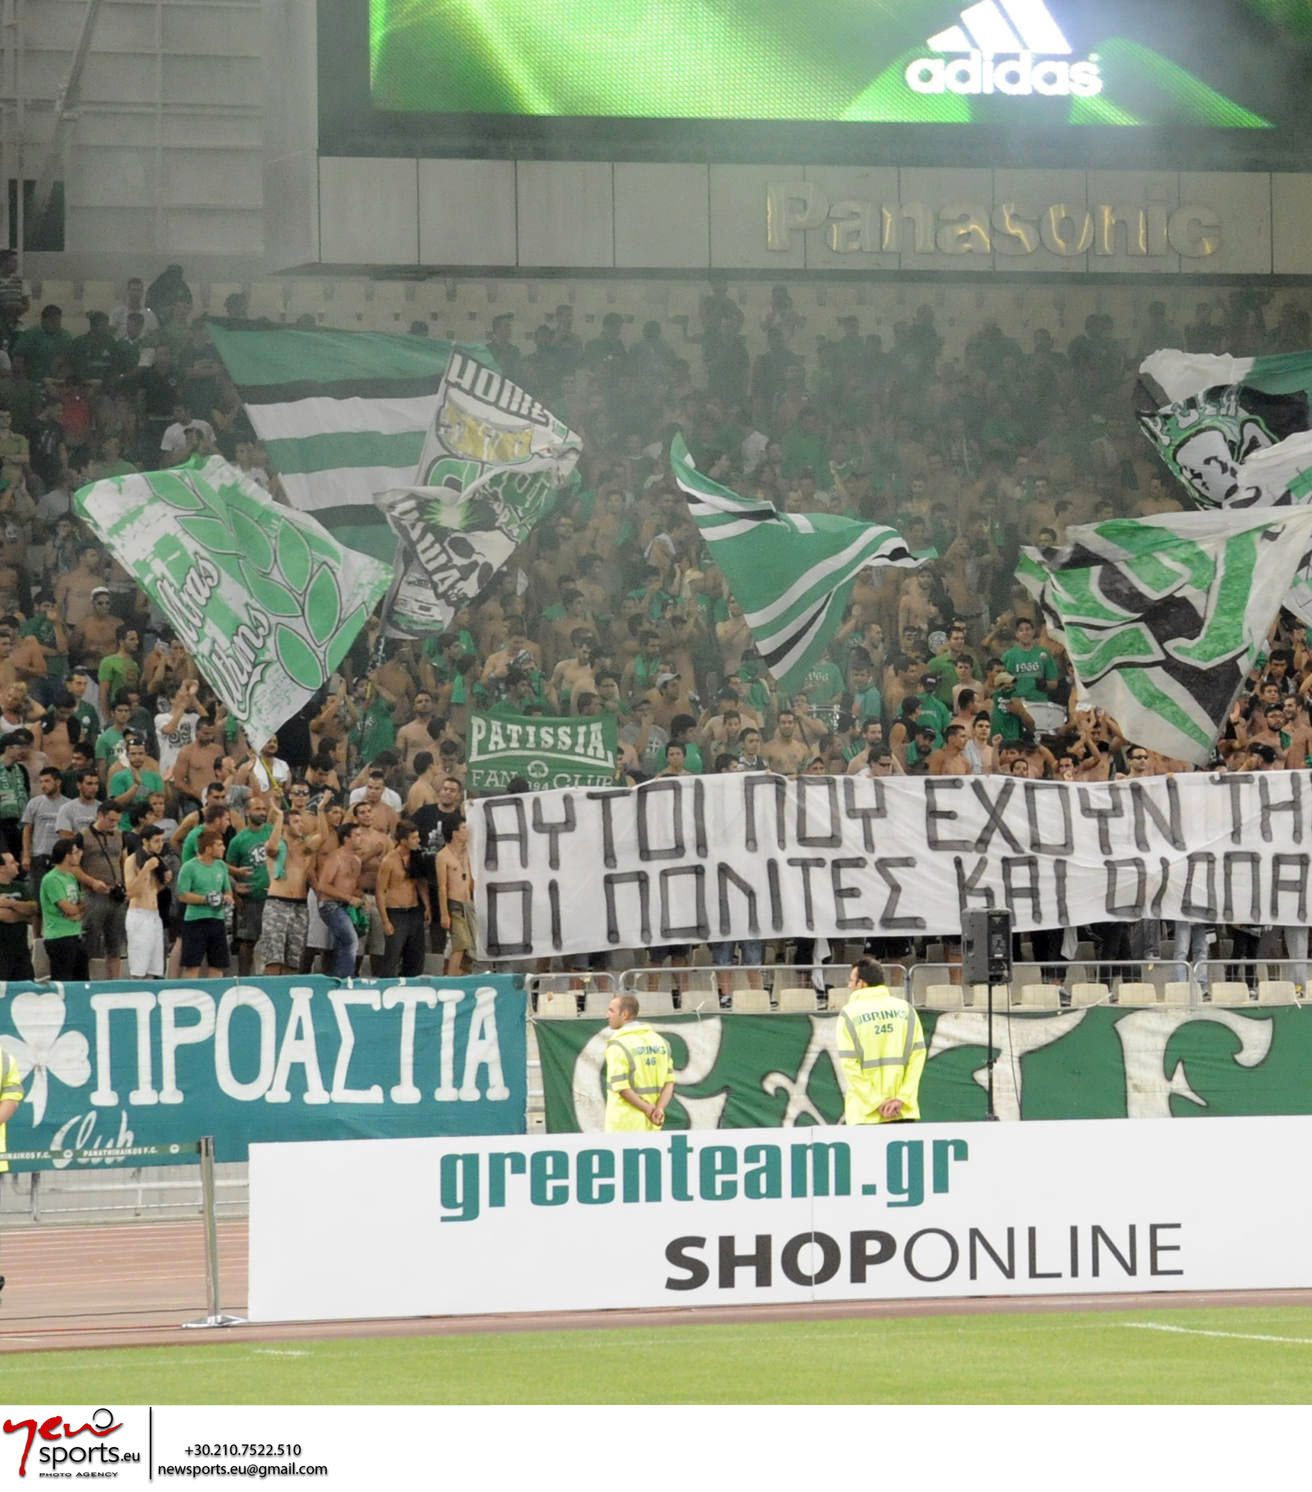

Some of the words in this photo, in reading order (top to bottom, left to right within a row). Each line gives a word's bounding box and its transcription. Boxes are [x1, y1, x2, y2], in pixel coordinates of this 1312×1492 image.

[905, 50, 1102, 96] adidas
[766, 181, 1222, 257] Panasonic
[470, 715, 606, 760] PATISSIA
[471, 769, 519, 788] FAN
[483, 780, 708, 870] ΑΥΤΟΙ
[743, 774, 887, 854] ΠΟΥ
[924, 777, 1187, 857] ΕΧΟΥΝ
[486, 878, 563, 956] ΟΙ
[602, 856, 928, 944] ΠΟΛΙΤΕΣ
[953, 855, 1069, 925] ΚΑΙ
[90, 985, 512, 1107] ΠΡΟΑΣΤΙΑ
[873, 1023, 894, 1035] 245
[439, 1134, 969, 1222] greenteam.gr
